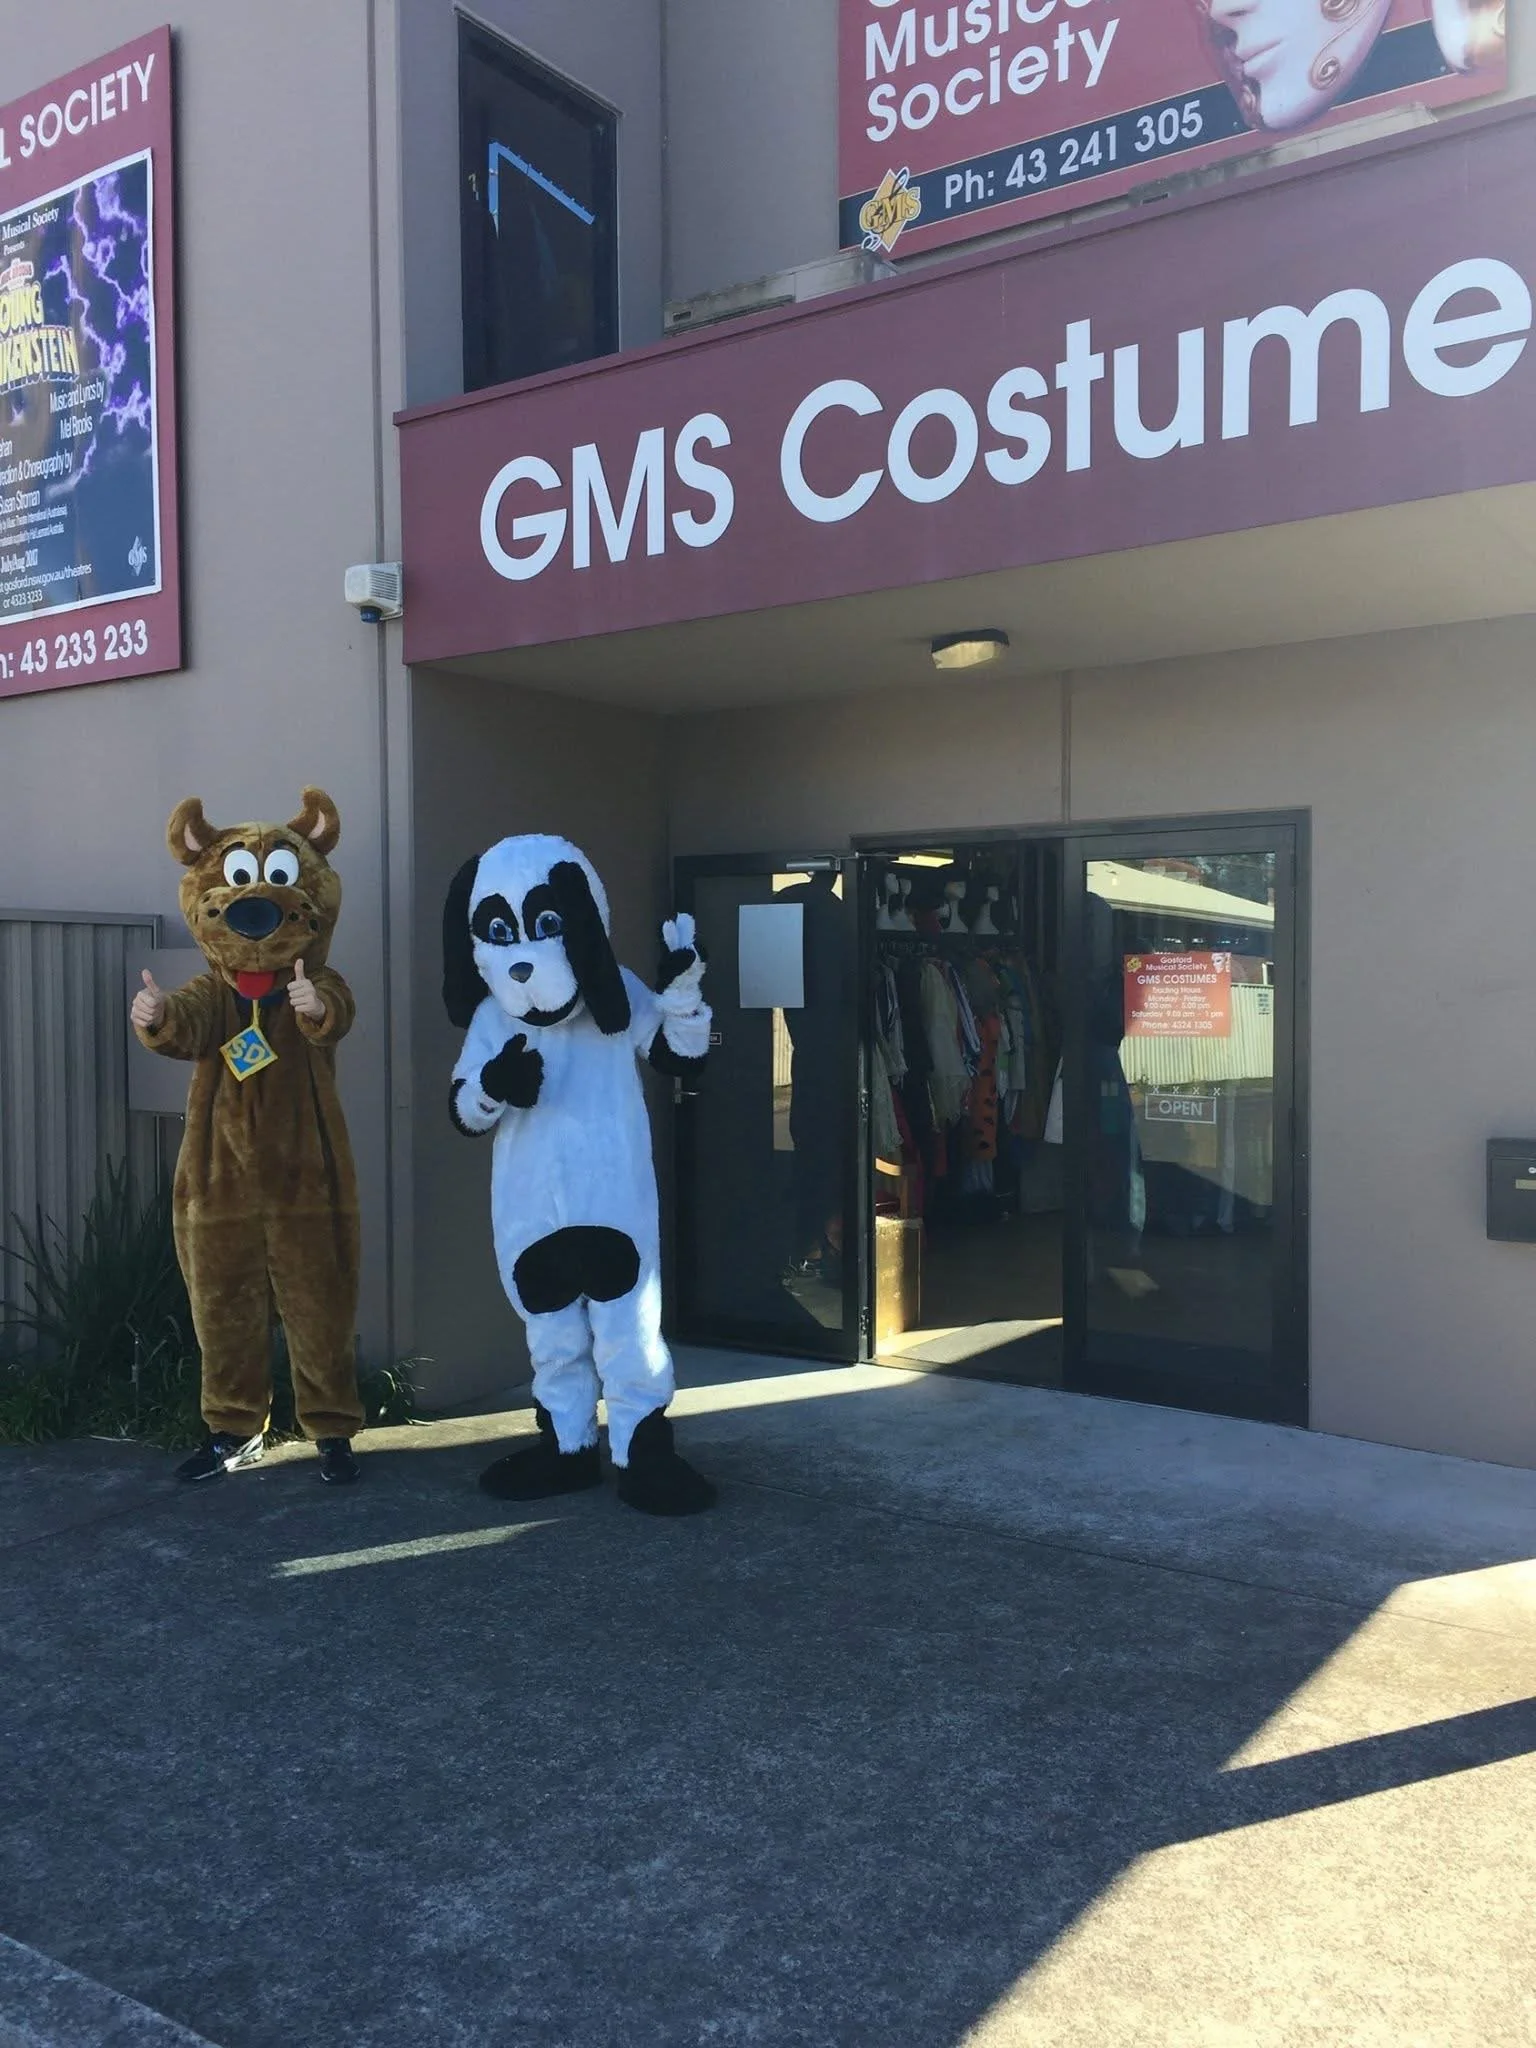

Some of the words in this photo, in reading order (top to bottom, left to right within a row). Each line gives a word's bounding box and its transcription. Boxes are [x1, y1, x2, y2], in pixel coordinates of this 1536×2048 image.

[866, 0, 1092, 80] Music
[866, 18, 1121, 142] Society
[20, 53, 155, 158] SOCIETY
[945, 168, 994, 208] Ph:
[1005, 148, 1048, 188] 43
[1059, 125, 1118, 176] 241
[1134, 99, 1204, 152] 305
[2, 215, 31, 241] Musical
[32, 207, 60, 229] Society
[861, 188, 920, 234] GMS
[96, 377, 104, 403] by
[72, 412, 92, 437] Brooks
[480, 412, 735, 581] GMS
[780, 257, 1533, 523] Costume
[18, 460, 23, 481] &
[23, 451, 64, 479] Choreography
[65, 449, 73, 473] by
[16, 490, 40, 510] Stroman
[27, 589, 43, 604] 3233
[20, 638, 48, 675] 43
[55, 629, 97, 669] 233
[104, 619, 148, 661] 233
[1146, 963, 1177, 971] Musical
[1178, 962, 1207, 971] Society
[1160, 956, 1192, 964] Gosford
[1137, 974, 1161, 985] GMS
[1163, 973, 1217, 984] COSTUMES
[1132, 1010, 1163, 1018] Saturday
[1194, 1021, 1214, 1030] 1305
[227, 1038, 266, 1064] SD
[1159, 1099, 1203, 1116] OPEN
